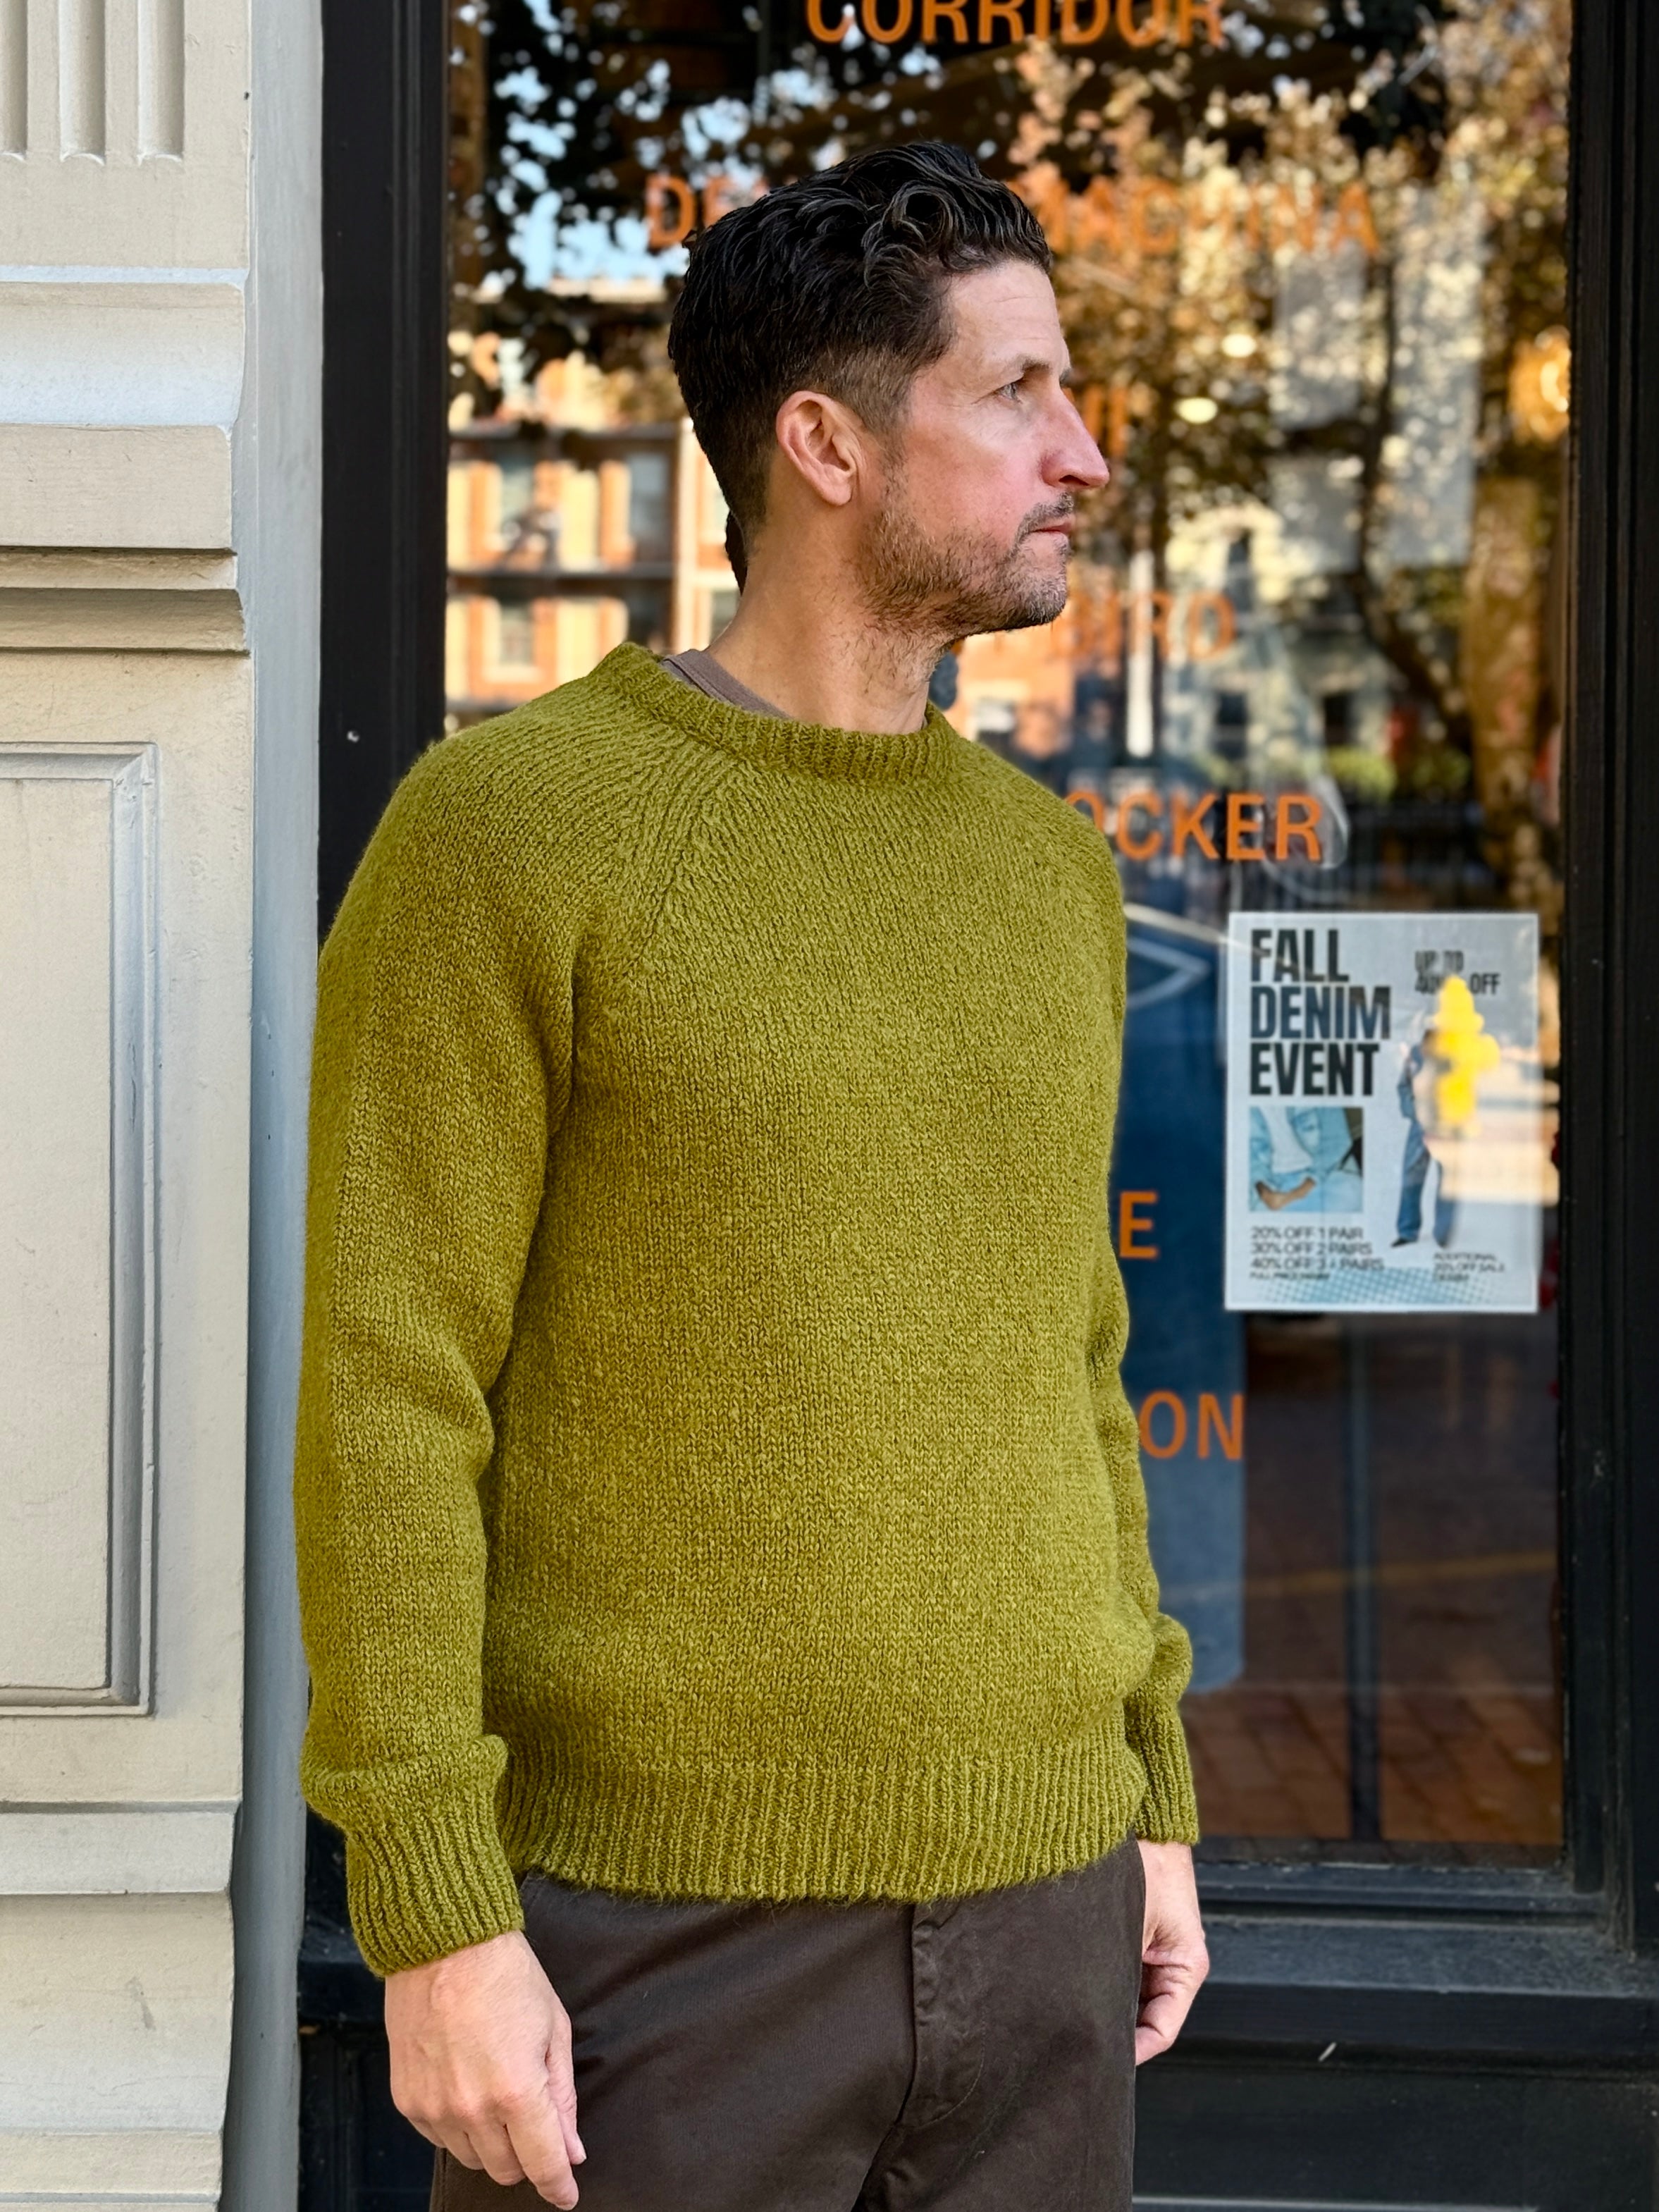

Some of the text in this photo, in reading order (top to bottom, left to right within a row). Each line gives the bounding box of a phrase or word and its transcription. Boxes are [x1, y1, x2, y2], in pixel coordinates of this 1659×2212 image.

[806, 0, 1223, 45] CORRIDOR
[1250, 929, 1350, 982] FALL
[1469, 973, 1500, 995] OFF
[1250, 986, 1391, 1039] DENIM
[1250, 1043, 1379, 1096] EVENT
[1251, 1227, 1282, 1239] 20%
[1284, 1227, 1315, 1239] OFF
[1328, 1227, 1364, 1239] PAIR
[1284, 1242, 1315, 1254] OFF
[1328, 1242, 1373, 1255] PAIRS
[1284, 1257, 1315, 1270] OFF
[1340, 1258, 1386, 1271] PAIRS
